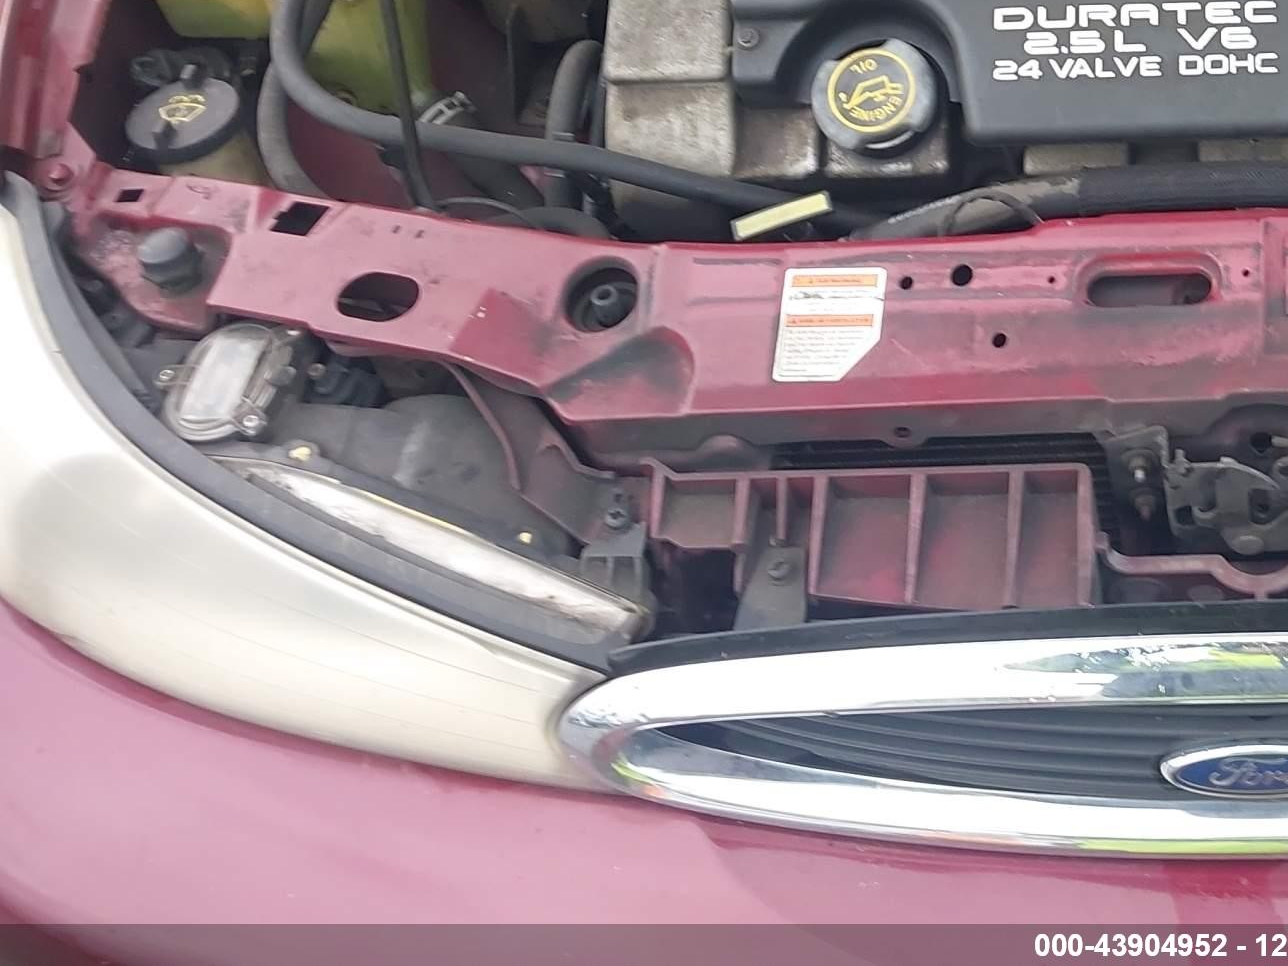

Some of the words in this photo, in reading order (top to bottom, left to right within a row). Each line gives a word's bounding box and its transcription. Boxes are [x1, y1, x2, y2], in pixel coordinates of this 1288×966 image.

[992, 0, 1278, 31] DURATEC
[1176, 26, 1258, 52] V6
[992, 58, 1044, 81] 24
[1047, 55, 1163, 79] VALVE
[1178, 52, 1279, 77] DOHC
